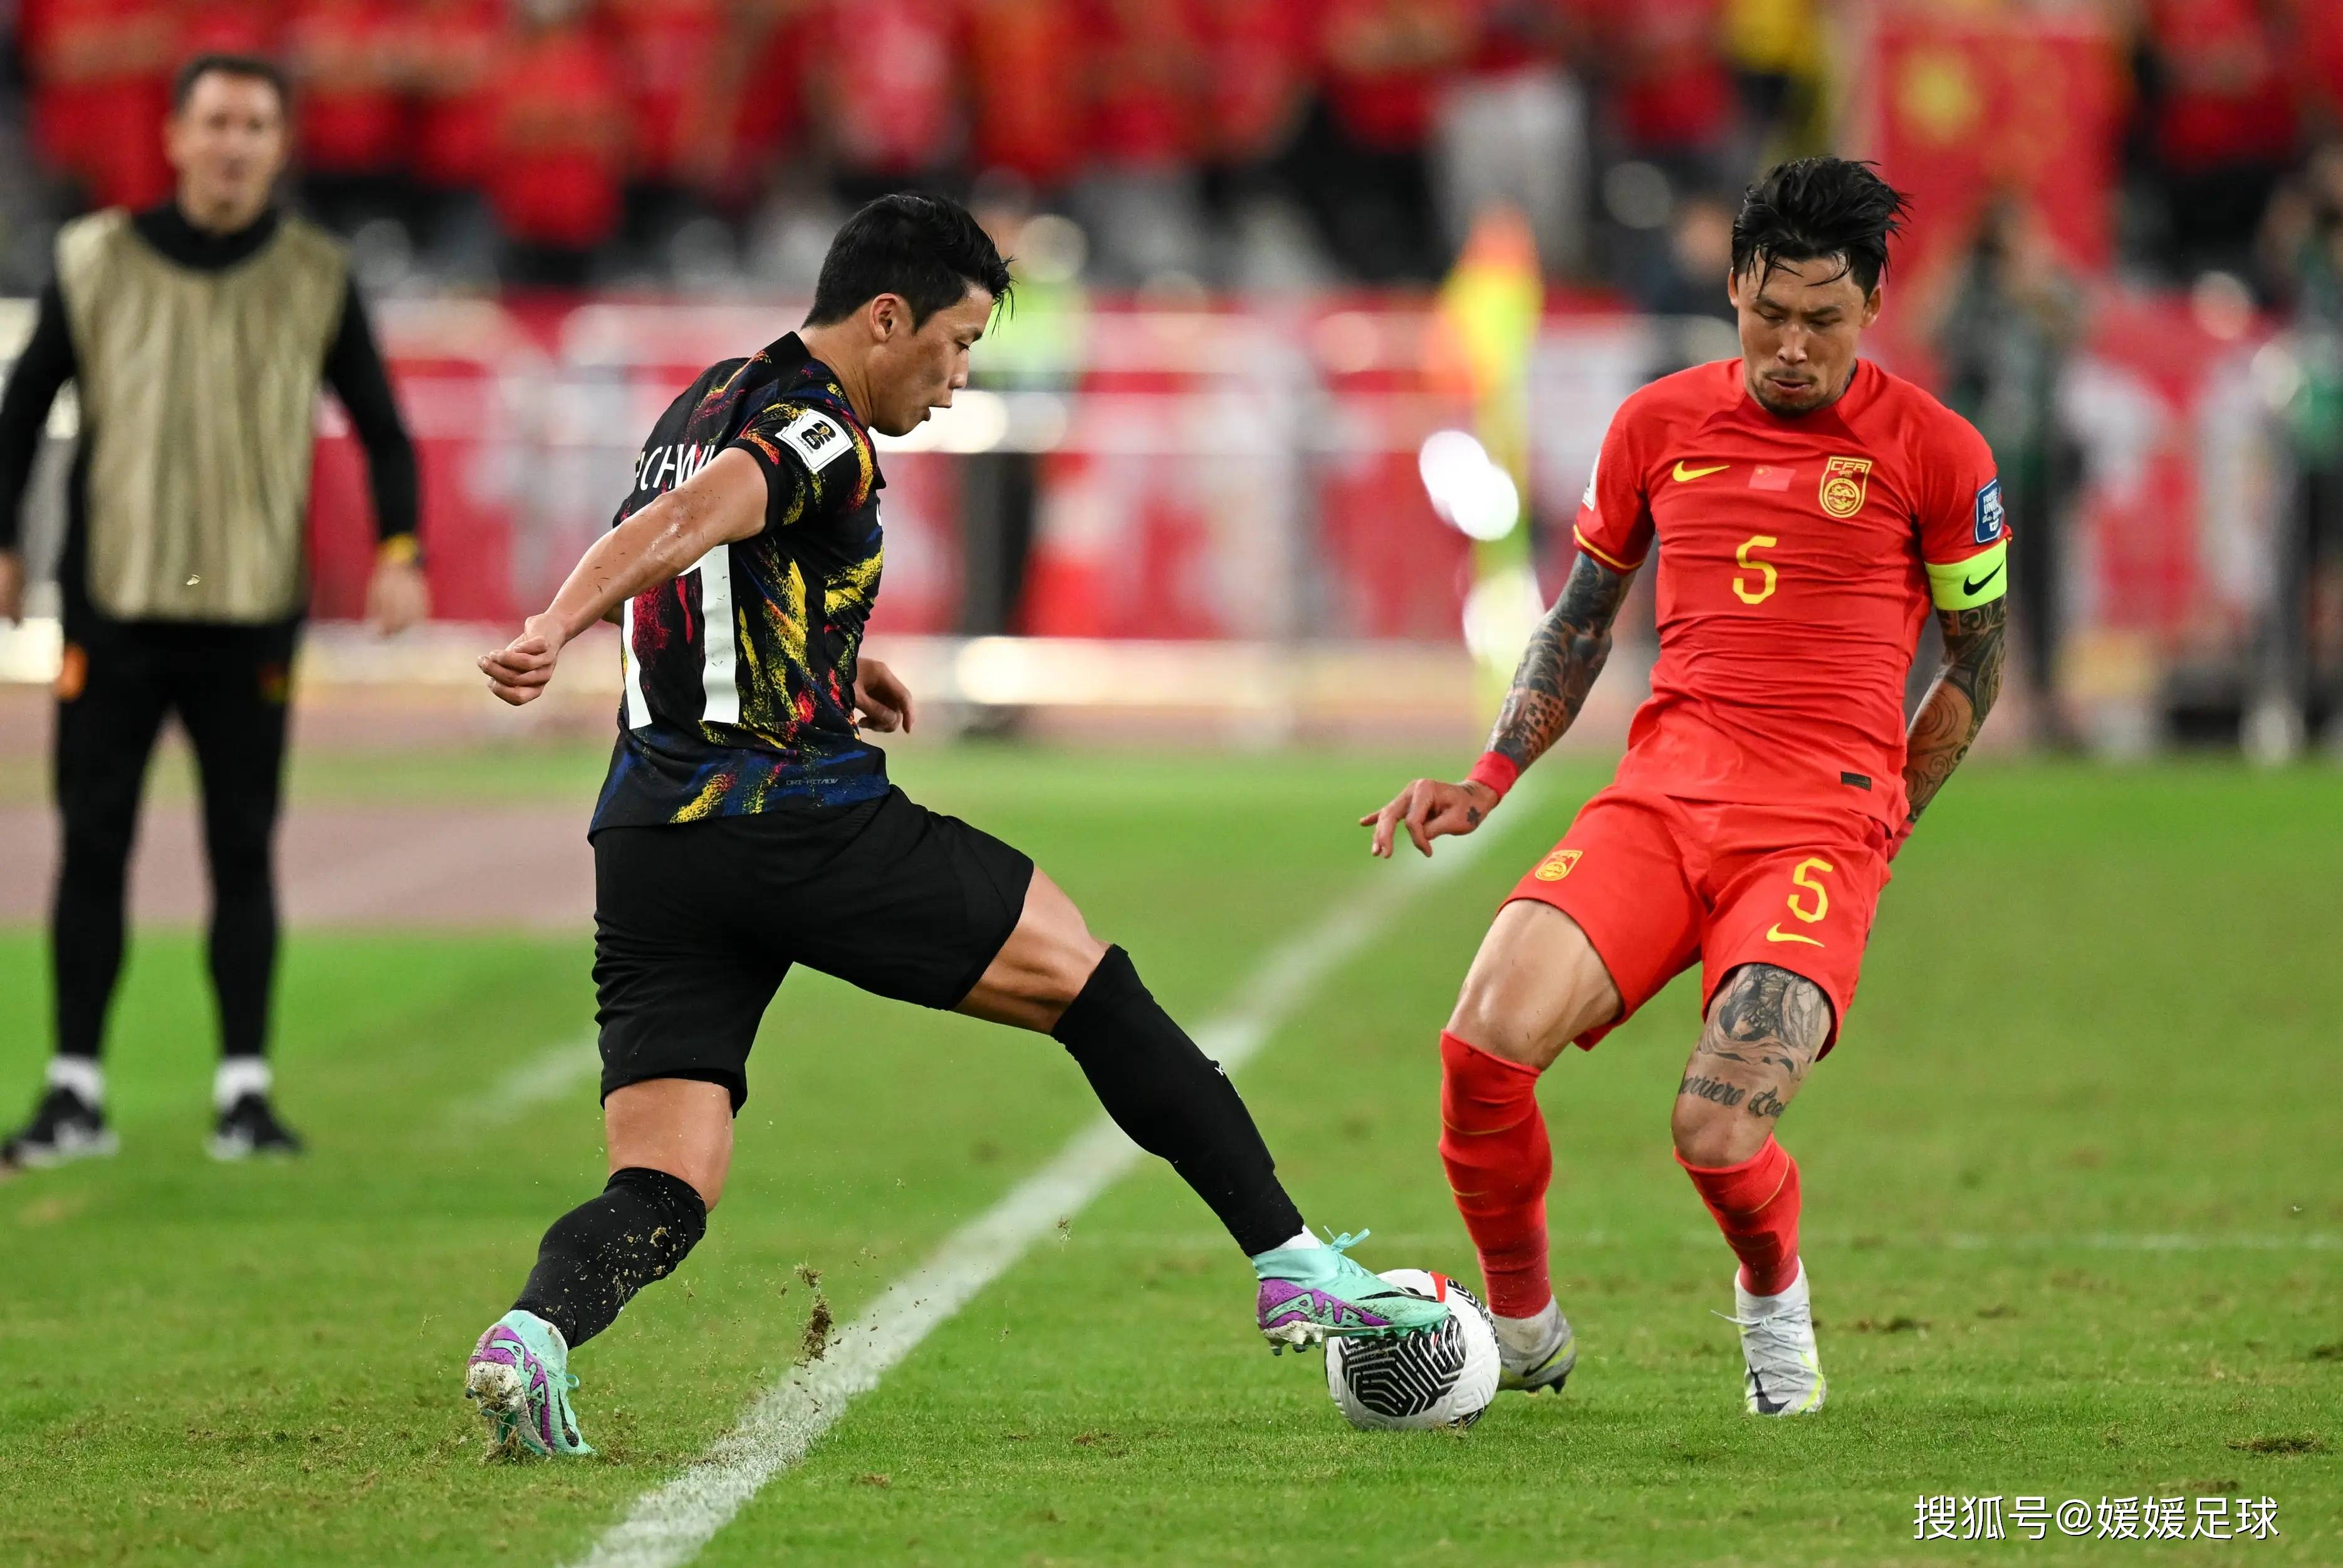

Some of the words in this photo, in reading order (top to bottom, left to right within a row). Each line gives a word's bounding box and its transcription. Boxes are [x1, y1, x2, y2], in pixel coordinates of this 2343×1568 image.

[1830, 460, 1867, 473] CFA
[1733, 536, 1778, 605] 5
[1787, 857, 1834, 923] 5
